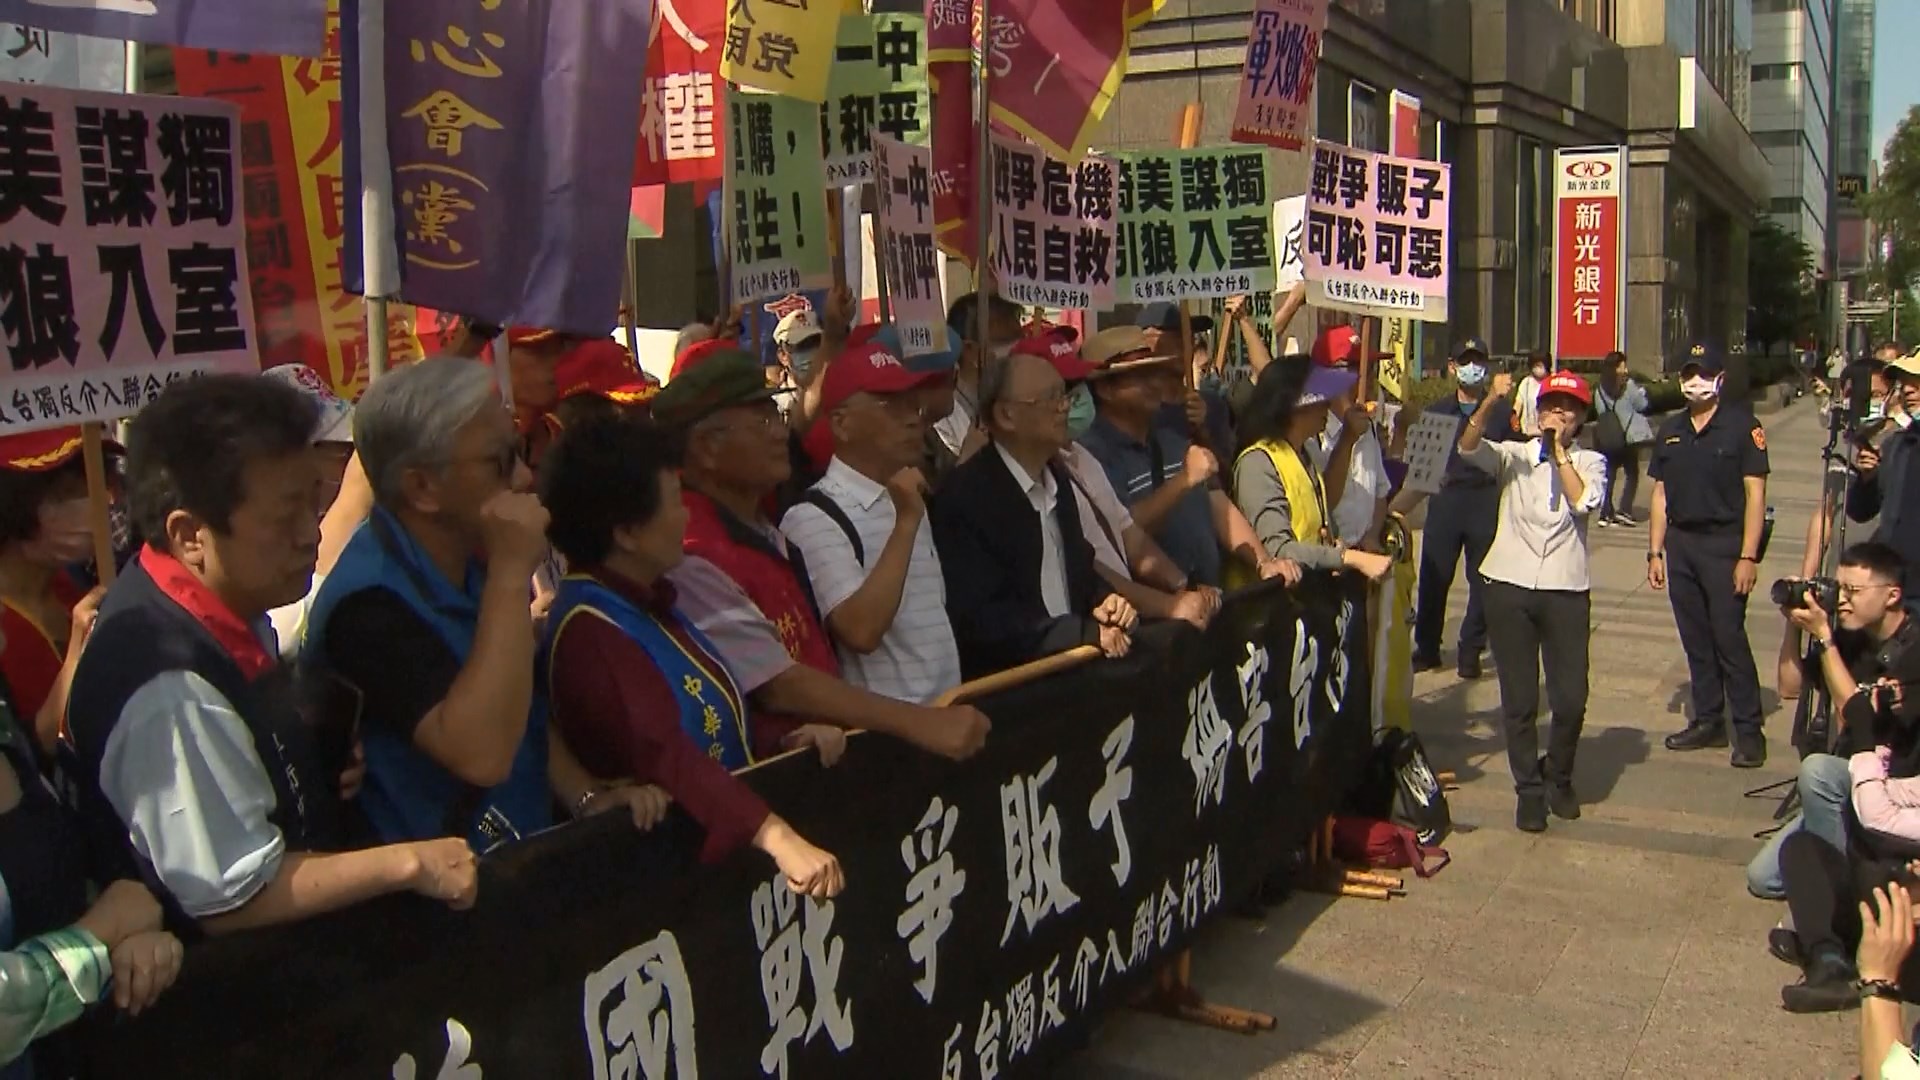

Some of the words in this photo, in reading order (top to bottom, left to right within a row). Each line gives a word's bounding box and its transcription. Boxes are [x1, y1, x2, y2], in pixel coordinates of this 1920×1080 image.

[835, 21, 918, 83] 一中
[396, 0, 504, 269] 心會(黨)
[819, 92, 921, 160] 和平
[0, 98, 234, 228] 美謀獨
[1311, 147, 1444, 220] 戰爭販子
[1567, 180, 1611, 191] 新光金控
[1308, 209, 1443, 279] 可恥可惡
[1572, 202, 1602, 325] 新光銀行
[1, 242, 247, 371] 狼入室
[1134, 276, 1250, 299] 反台獨反介入聯合行動
[1327, 278, 1420, 306] 反台獨反介入聯合行動
[0, 368, 205, 425] 台獨反介入聯合
